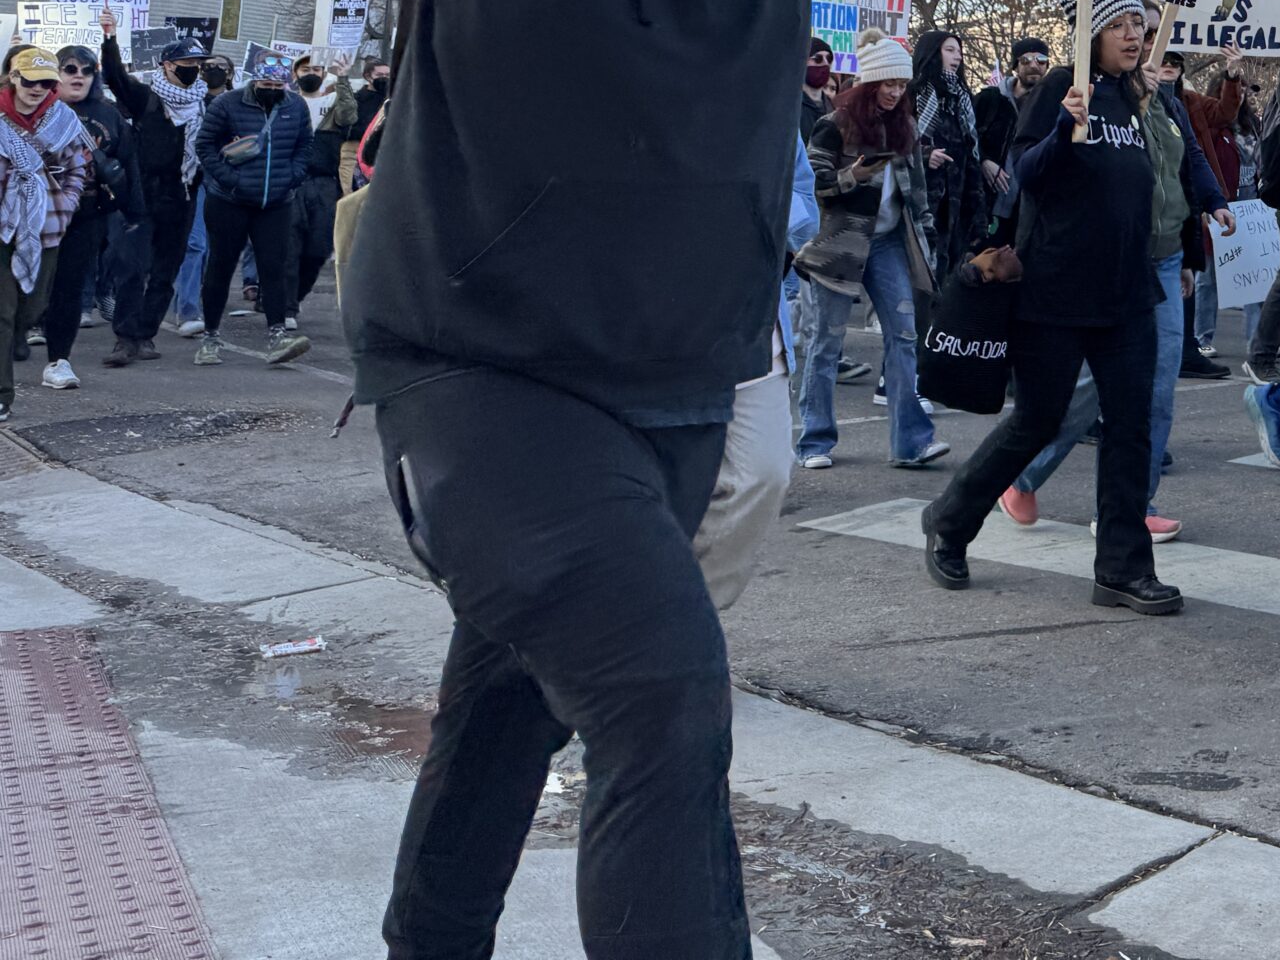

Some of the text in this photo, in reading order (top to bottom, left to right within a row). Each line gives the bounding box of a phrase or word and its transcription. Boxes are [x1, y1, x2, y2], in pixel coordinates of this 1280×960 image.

[24, 3, 77, 26] ICE
[812, 2, 858, 31] ATION
[932, 331, 1008, 360] SALVADOR
